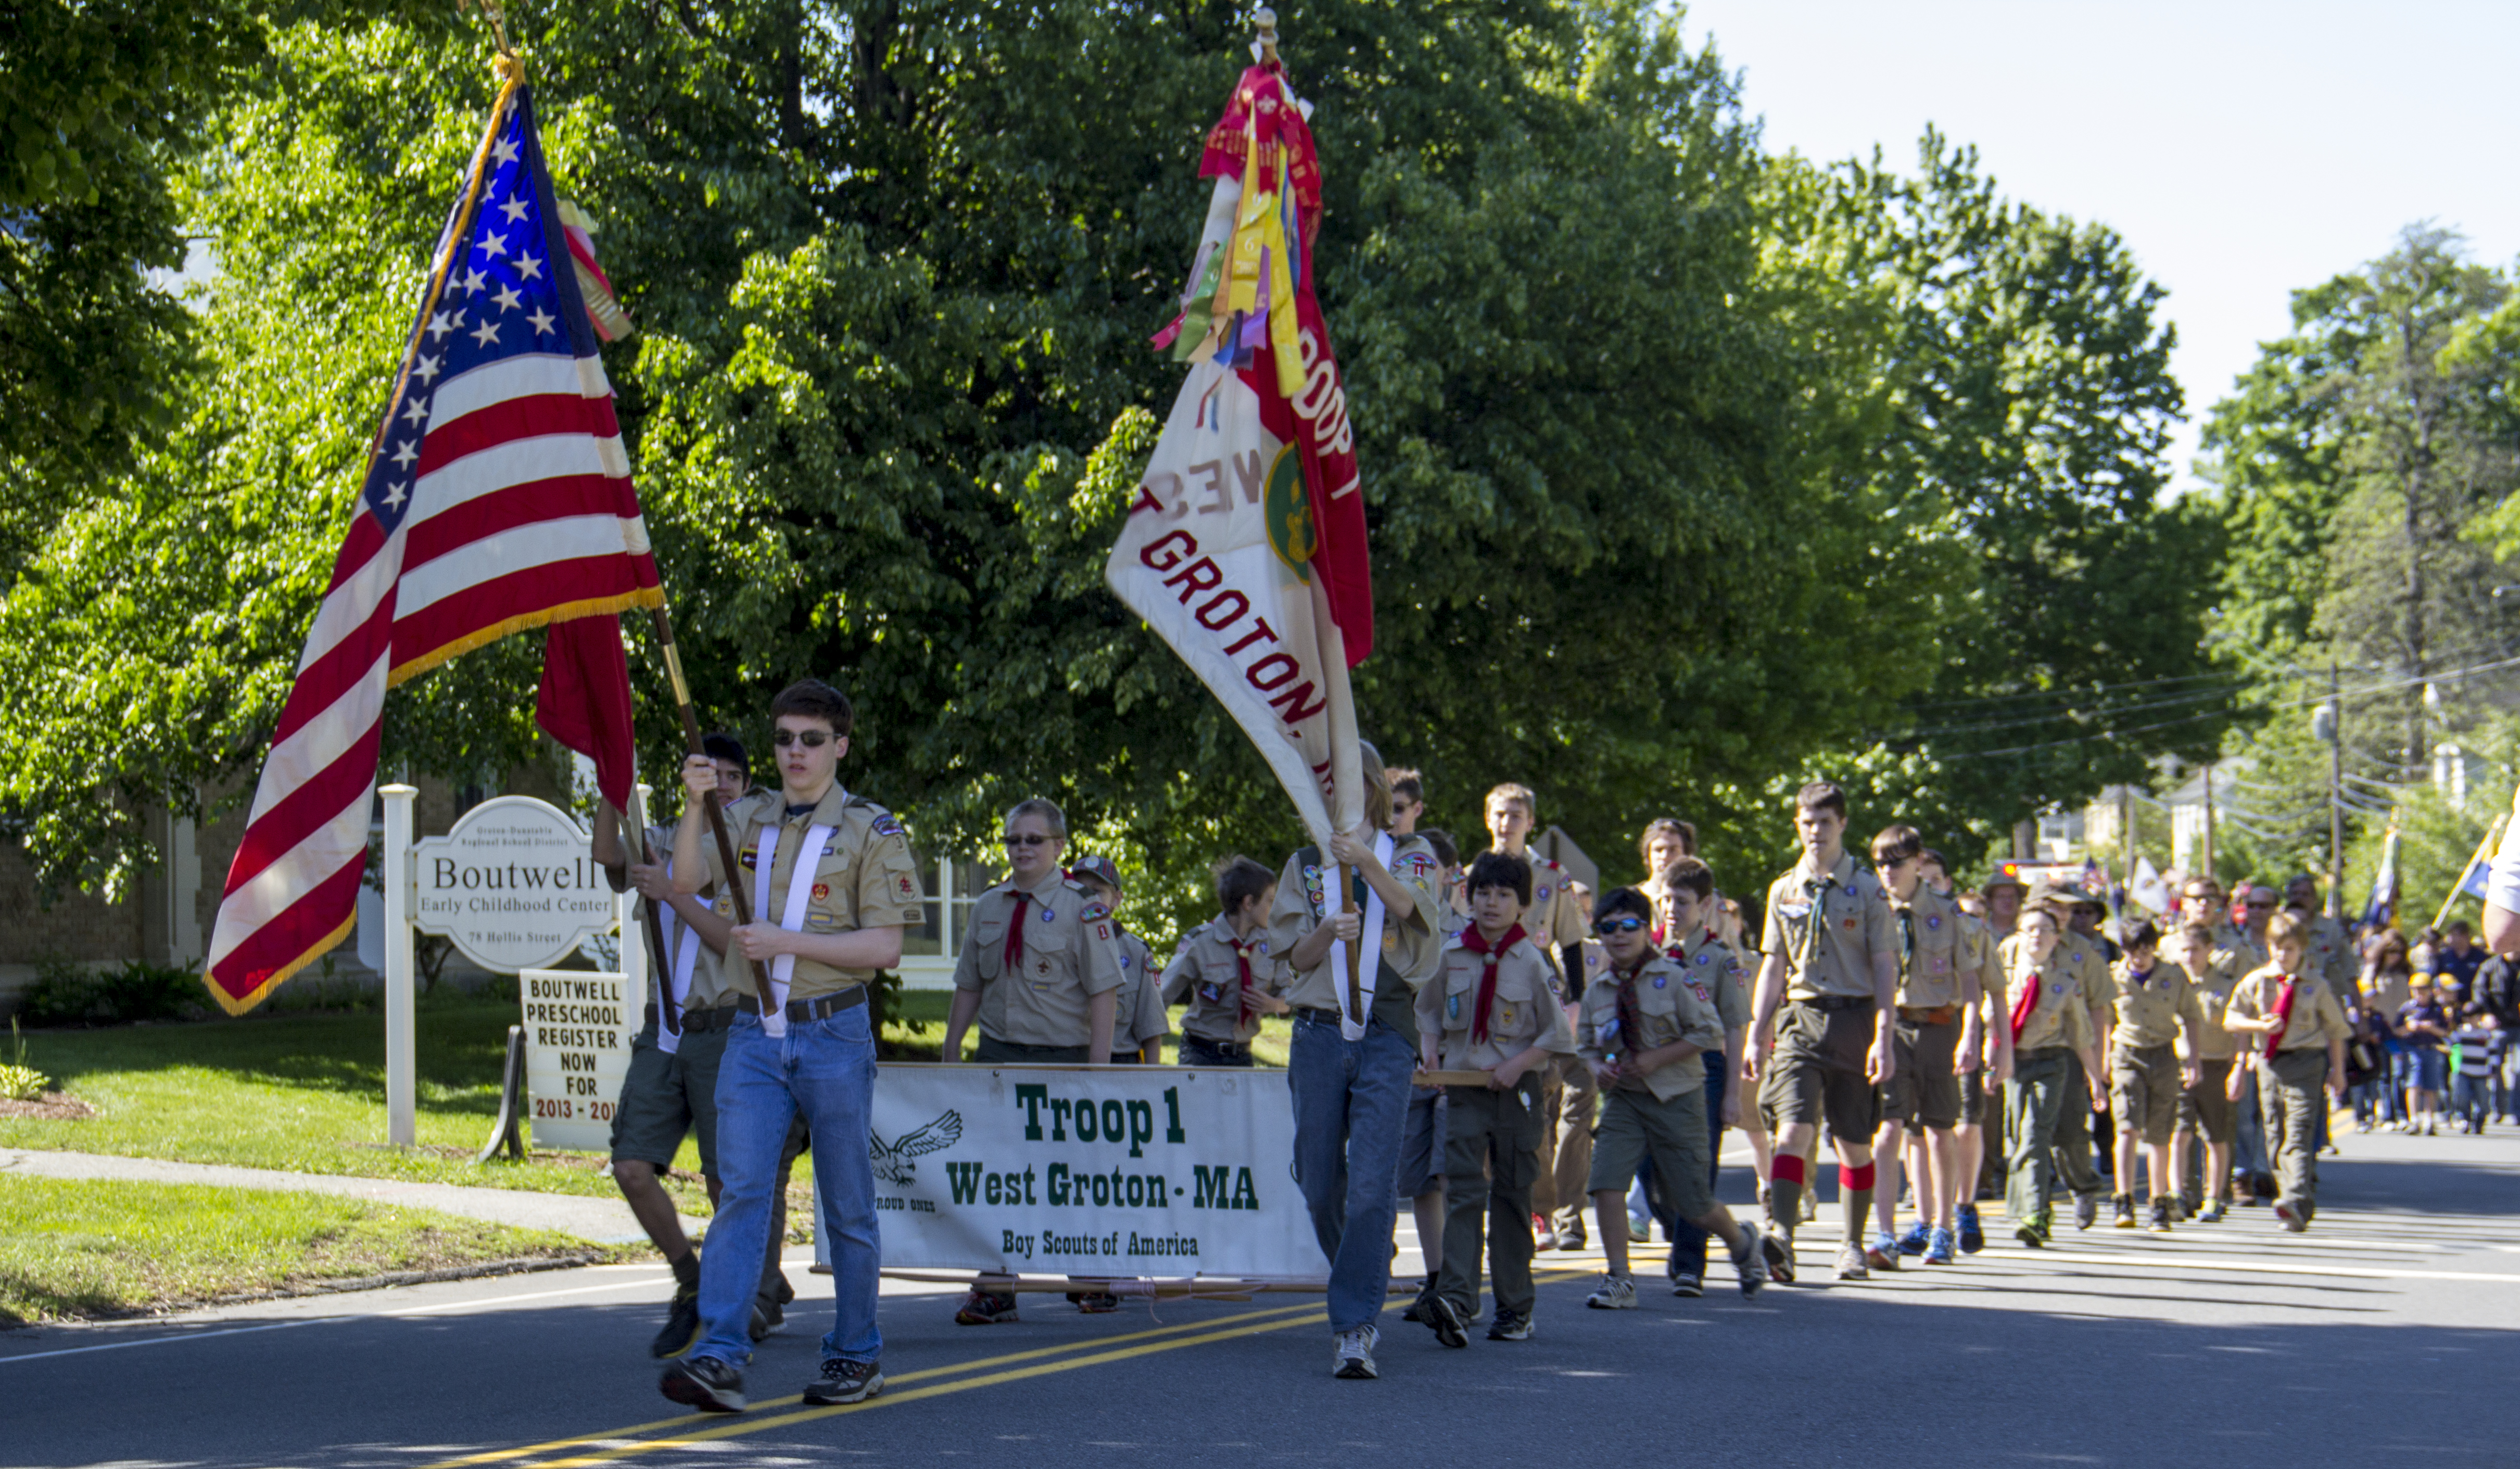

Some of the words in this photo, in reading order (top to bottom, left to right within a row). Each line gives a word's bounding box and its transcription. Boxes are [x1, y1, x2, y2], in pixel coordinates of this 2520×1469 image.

[433, 856, 598, 890] Boutwell
[421, 897, 462, 914] Early
[470, 897, 550, 911] Childhood
[558, 897, 610, 911] Center
[470, 932, 482, 942] 78
[487, 932, 522, 942] Hollis
[527, 932, 561, 942] Street
[530, 980, 620, 1001] BOUTWELL
[527, 1003, 621, 1025] PRESCHOOL
[538, 1028, 617, 1048] REGISTER
[561, 1052, 596, 1071] NOW
[566, 1076, 597, 1096] FOR
[536, 1098, 572, 1118] 2013
[590, 1101, 616, 1120] 201
[1015, 1083, 1153, 1158] Troop
[1163, 1086, 1185, 1143] 1
[946, 1162, 1036, 1205] West
[1048, 1162, 1168, 1208] Groton
[1193, 1164, 1259, 1210] MA
[875, 1197, 904, 1210] ROUD
[911, 1199, 935, 1212] ONES
[1002, 1230, 1035, 1259] Boy
[1043, 1230, 1097, 1256] Scouts
[1102, 1231, 1118, 1256] of
[1127, 1231, 1199, 1256] America
